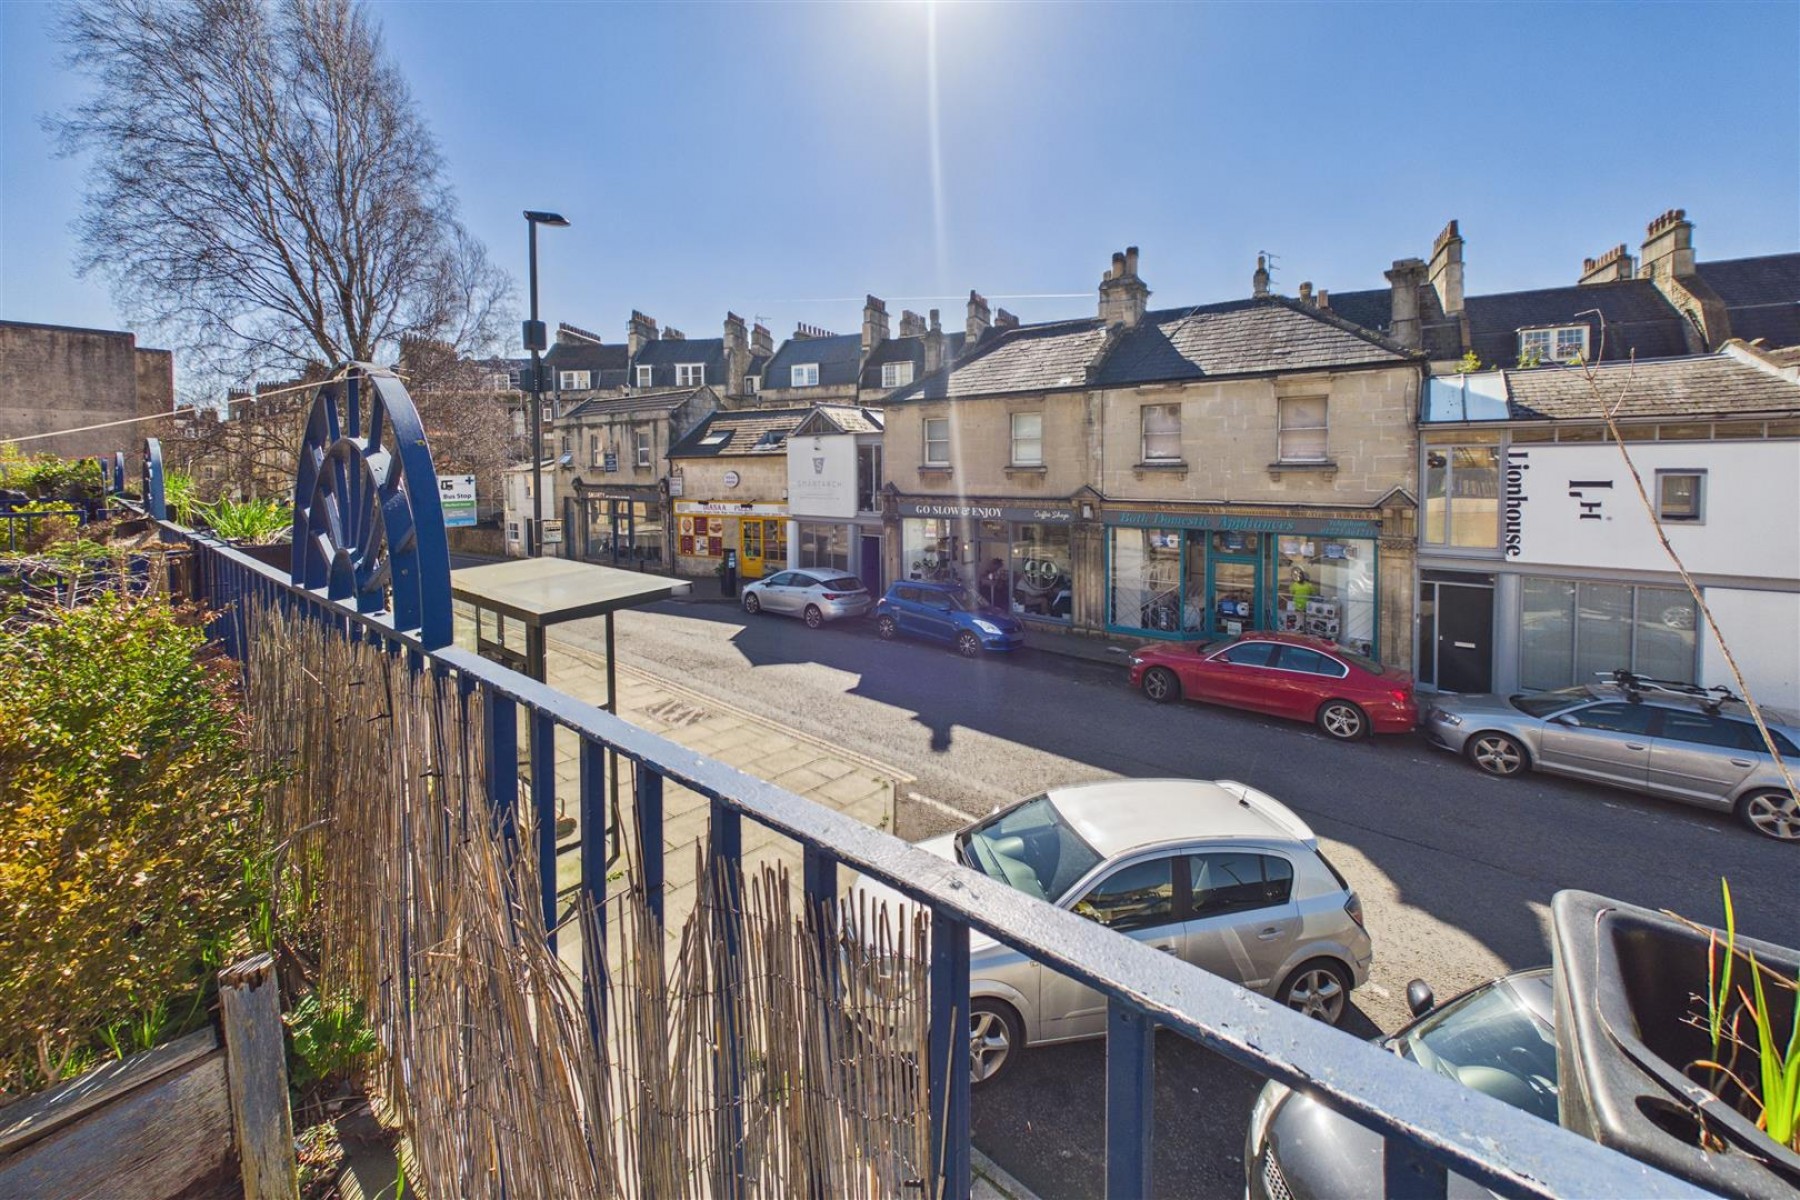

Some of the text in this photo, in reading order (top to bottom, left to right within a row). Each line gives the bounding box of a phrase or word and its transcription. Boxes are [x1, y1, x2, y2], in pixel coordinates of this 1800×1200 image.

[456, 492, 472, 501] Stop
[1506, 452, 1529, 557] Lionhouse
[915, 505, 1003, 518] GO SLOW & ENJOY
[1119, 511, 1297, 532] Bath Domestic Appliances
